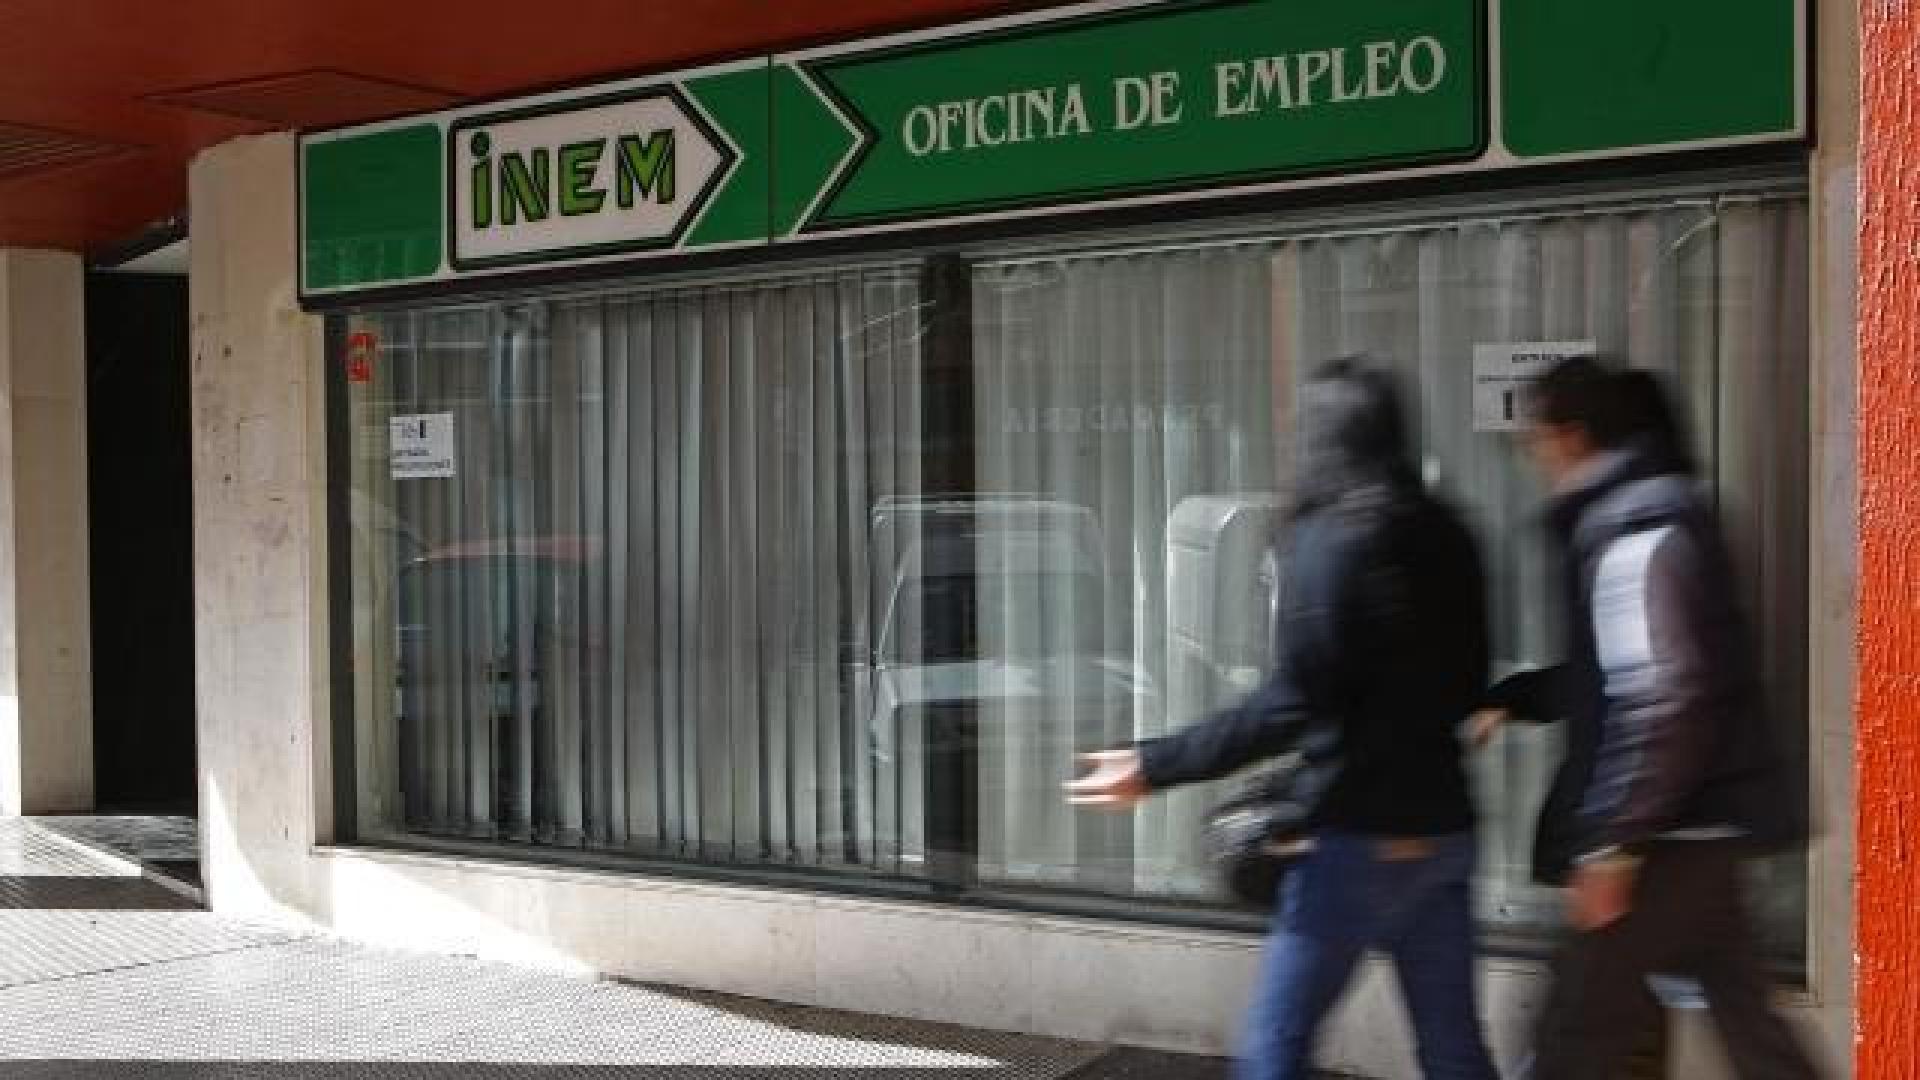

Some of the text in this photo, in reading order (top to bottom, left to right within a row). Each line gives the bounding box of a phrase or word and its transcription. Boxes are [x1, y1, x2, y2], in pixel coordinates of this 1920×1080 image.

[902, 35, 1447, 157] OFICINA DE EMPLEO
